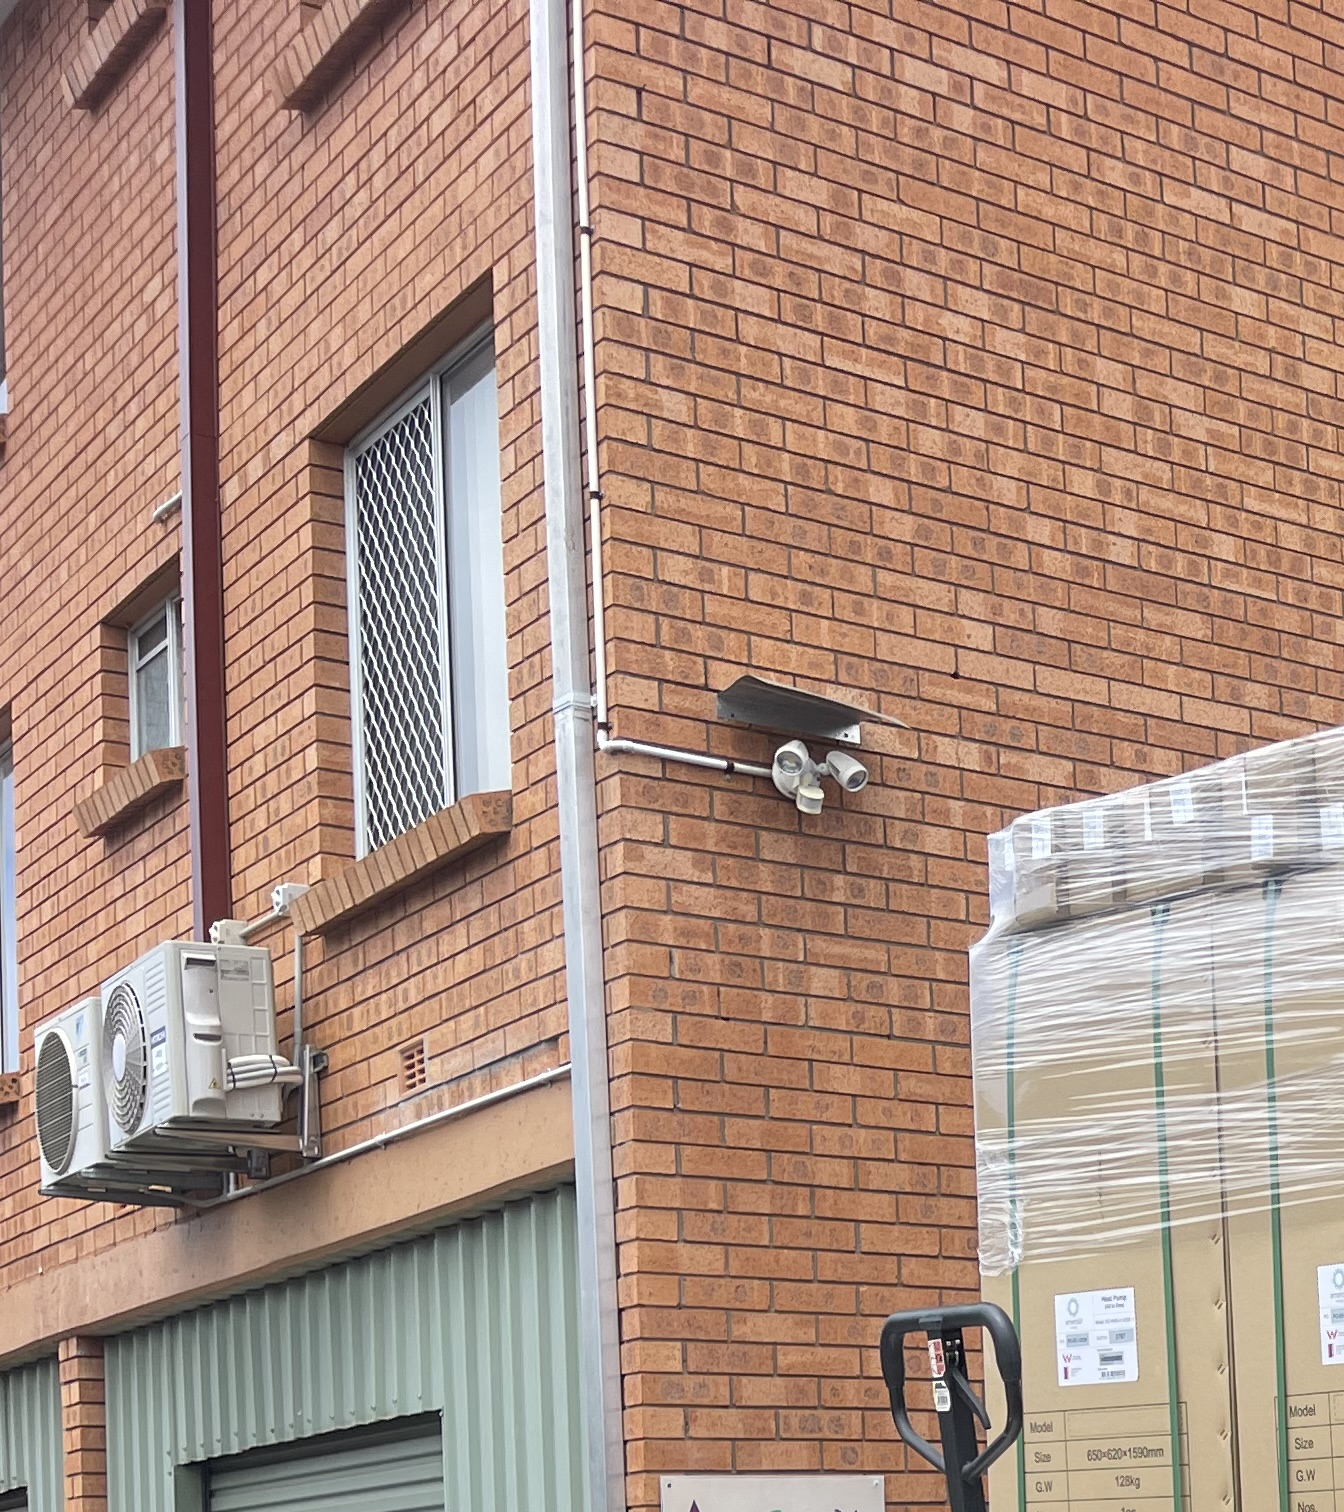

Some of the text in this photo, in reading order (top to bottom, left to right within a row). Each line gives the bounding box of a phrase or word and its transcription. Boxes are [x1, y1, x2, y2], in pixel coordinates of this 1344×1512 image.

[1289, 1404, 1316, 1418] Model
[1030, 1421, 1053, 1434] Model
[1294, 1437, 1314, 1450] Size
[1034, 1451, 1051, 1463] Size
[1295, 1468, 1316, 1482] G.W
[1035, 1475, 1140, 1493] G.W 128kg
